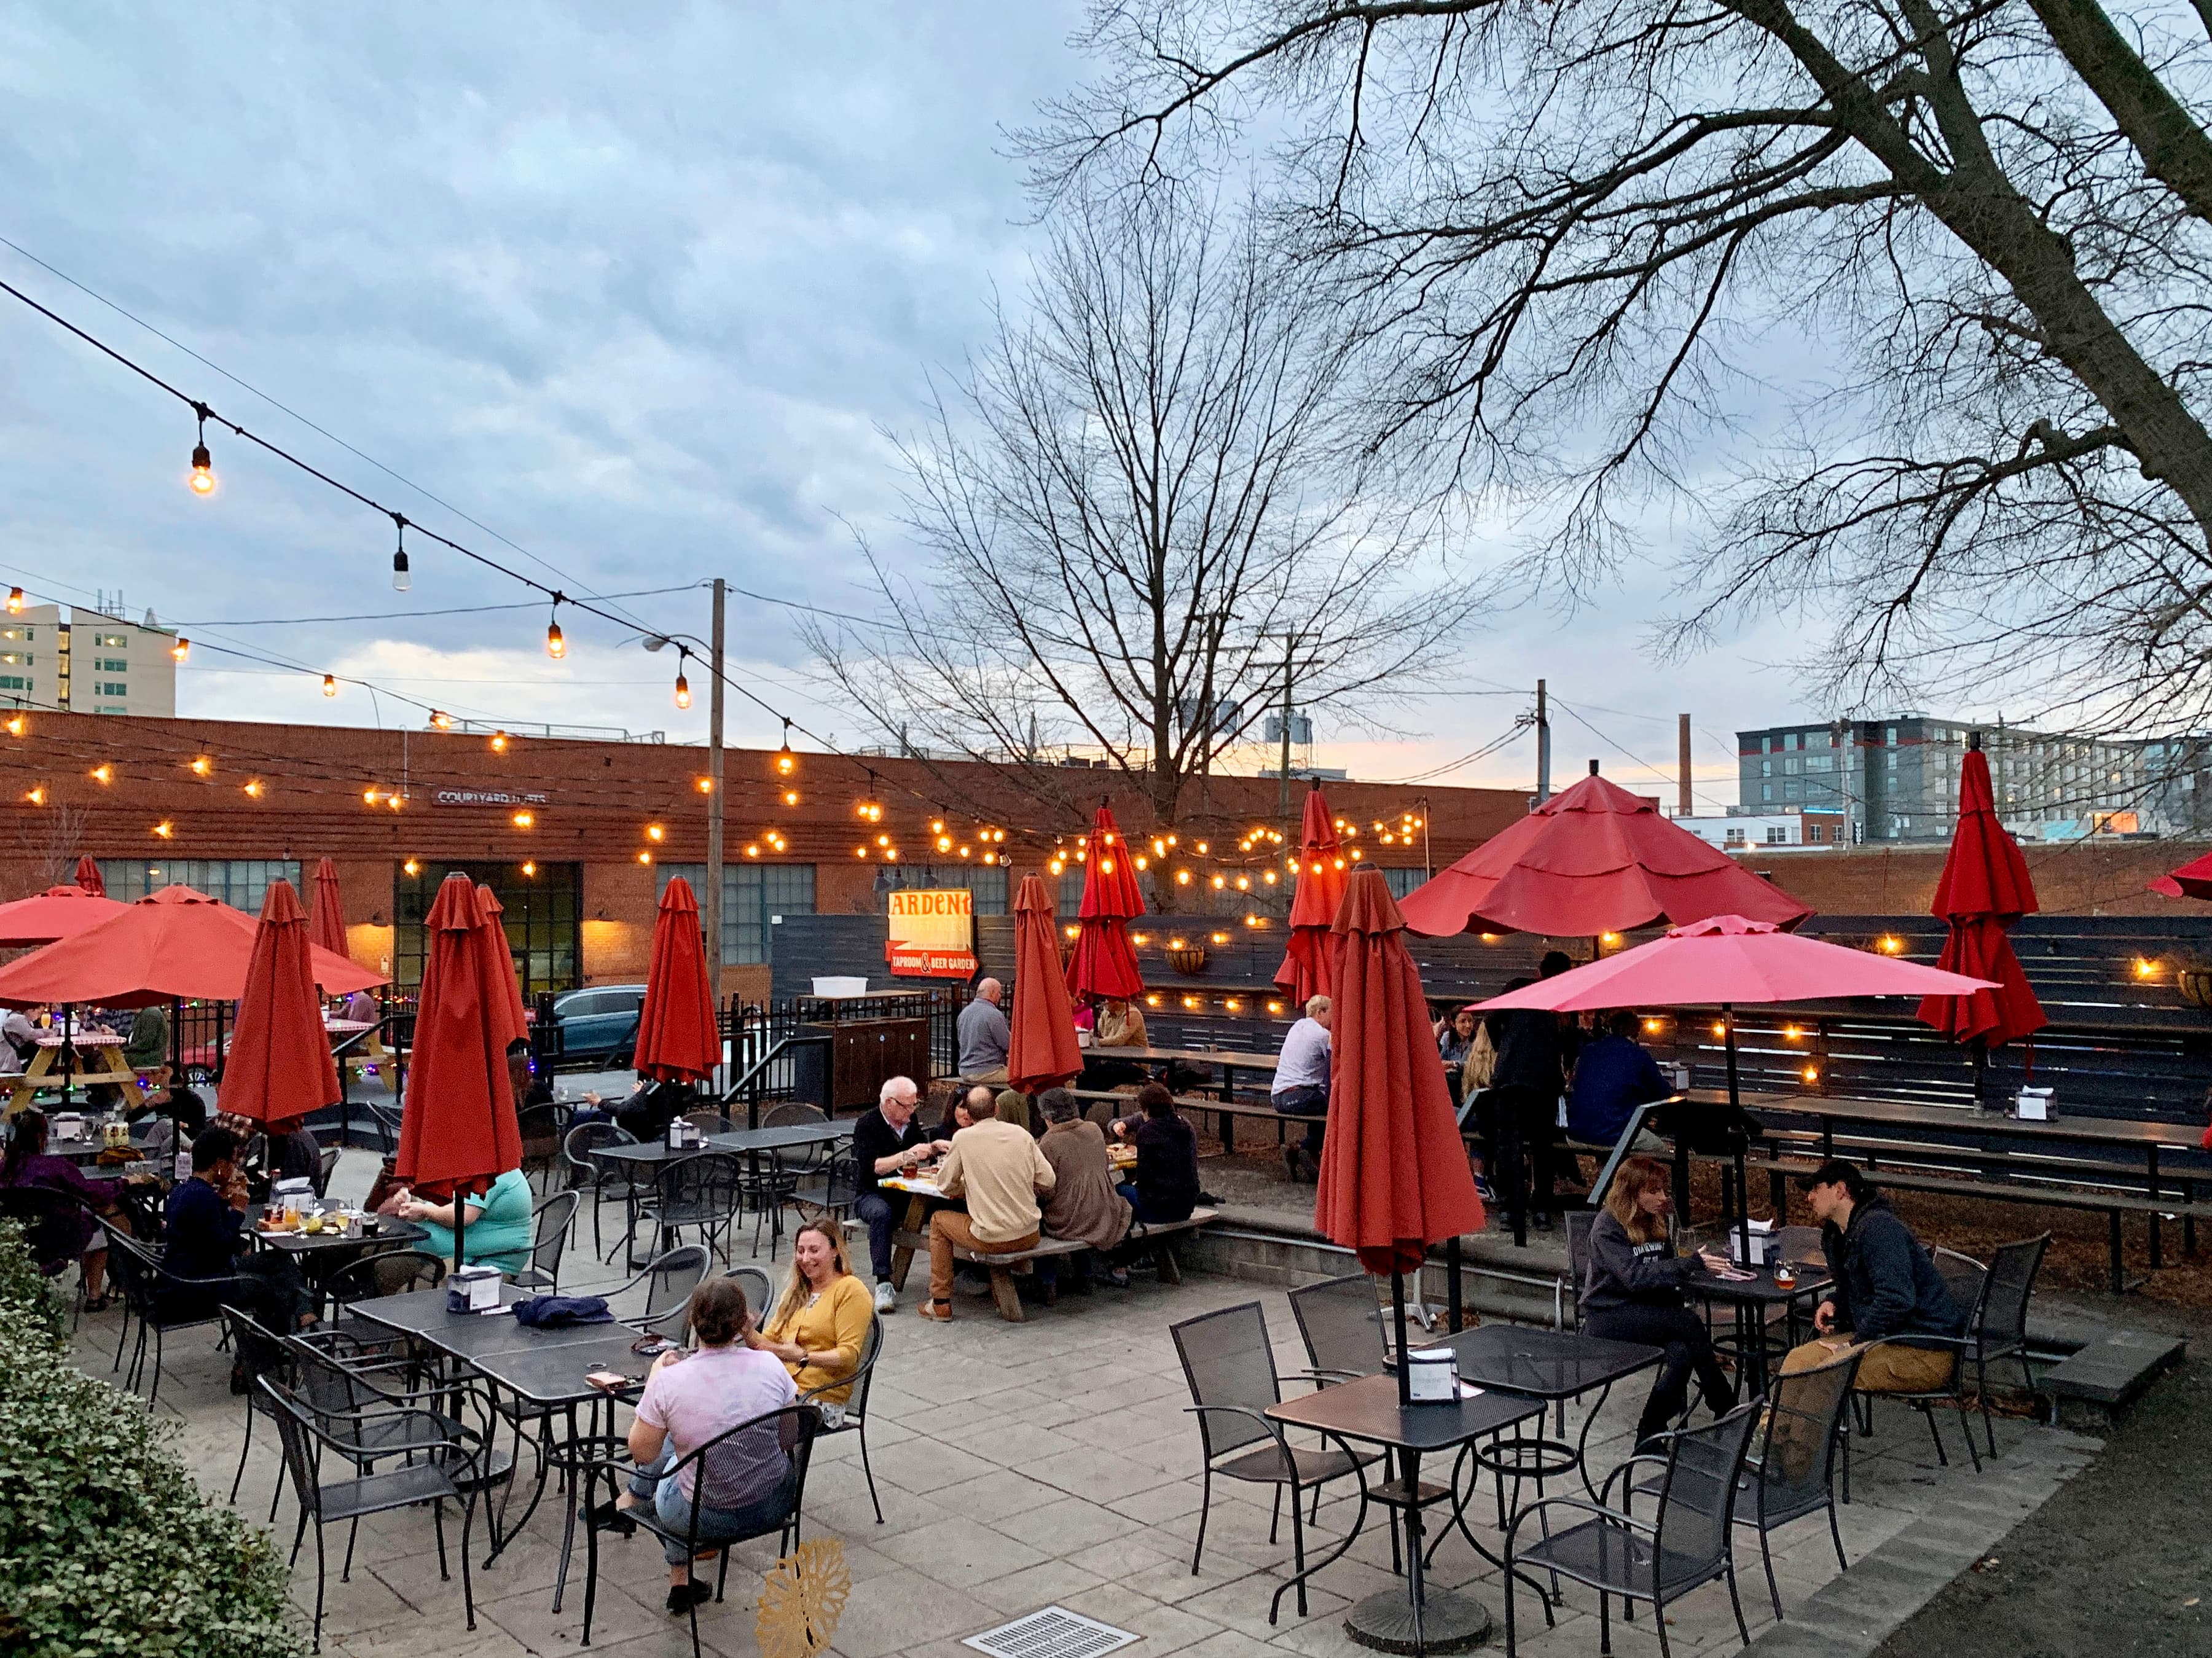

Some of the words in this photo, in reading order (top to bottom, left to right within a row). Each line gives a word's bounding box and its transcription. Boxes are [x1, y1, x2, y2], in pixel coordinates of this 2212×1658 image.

[438, 791, 509, 803] COURTYARD
[892, 956, 922, 968] TAPROOM
[921, 952, 931, 974] &
[931, 957, 947, 969] BEER
[948, 958, 975, 970] GARDEN
